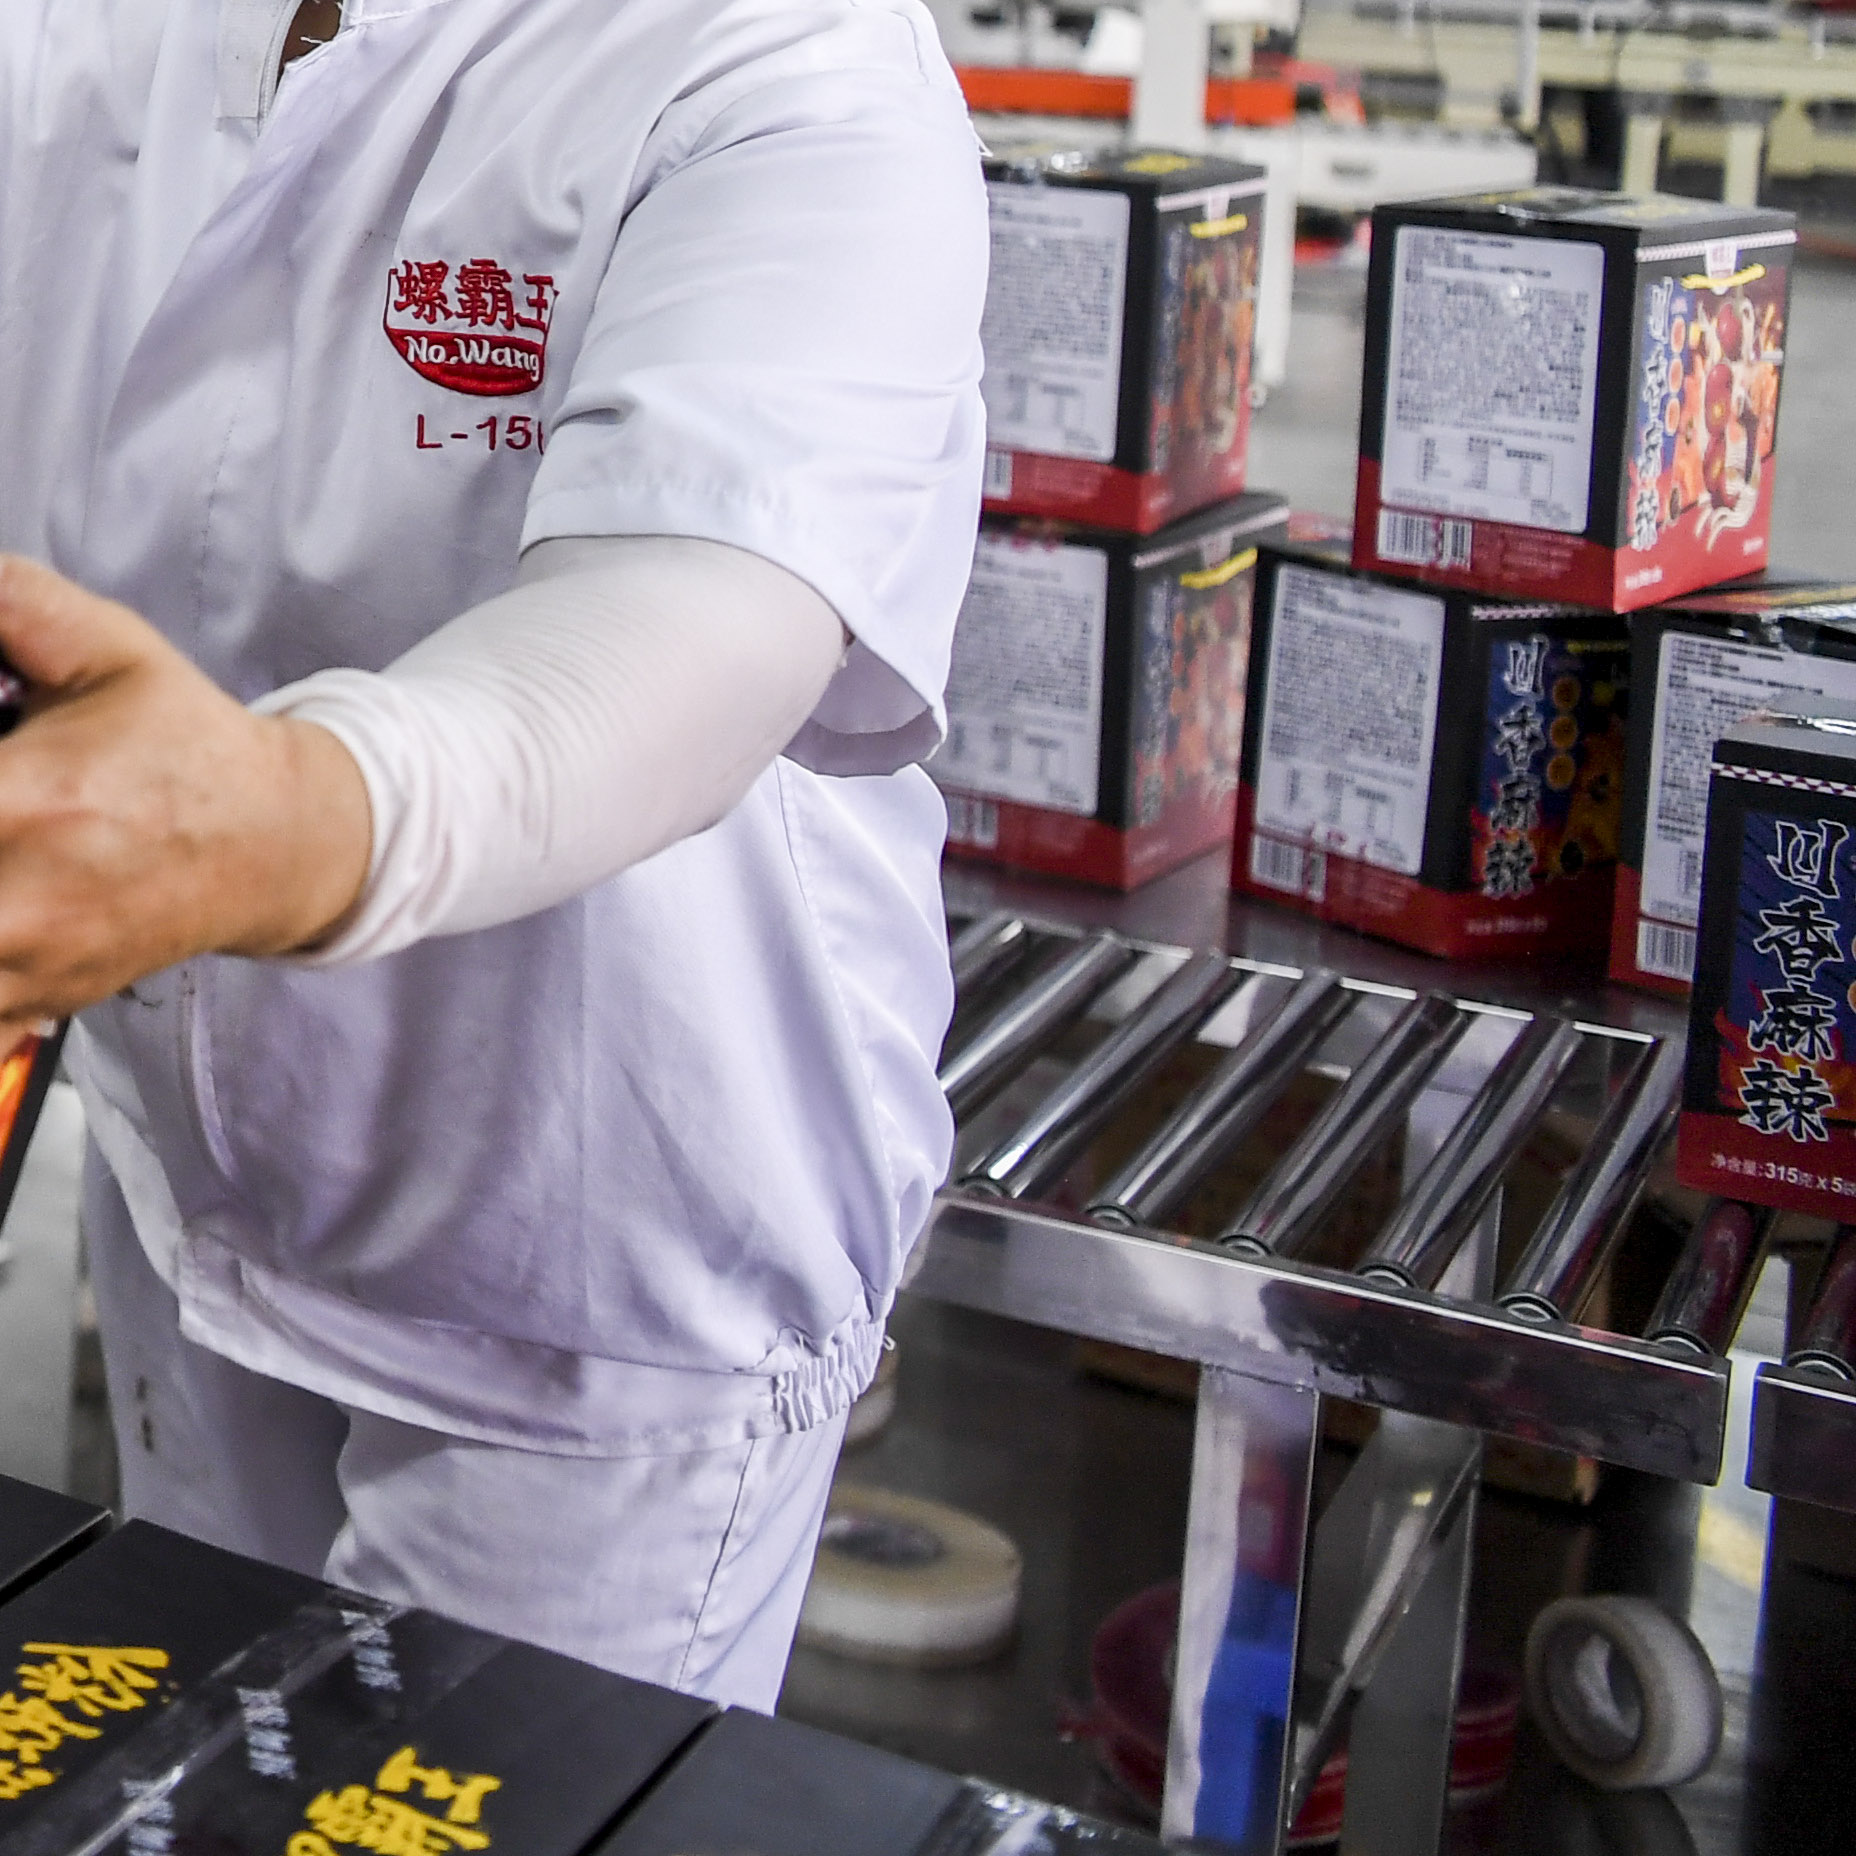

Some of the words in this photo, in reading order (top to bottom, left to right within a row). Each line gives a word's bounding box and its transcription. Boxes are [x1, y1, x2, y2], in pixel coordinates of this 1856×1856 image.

[394, 259, 554, 330] 螺霸王
[416, 414, 544, 455] L-15
[1738, 819, 1848, 1142] 川香麻辣
